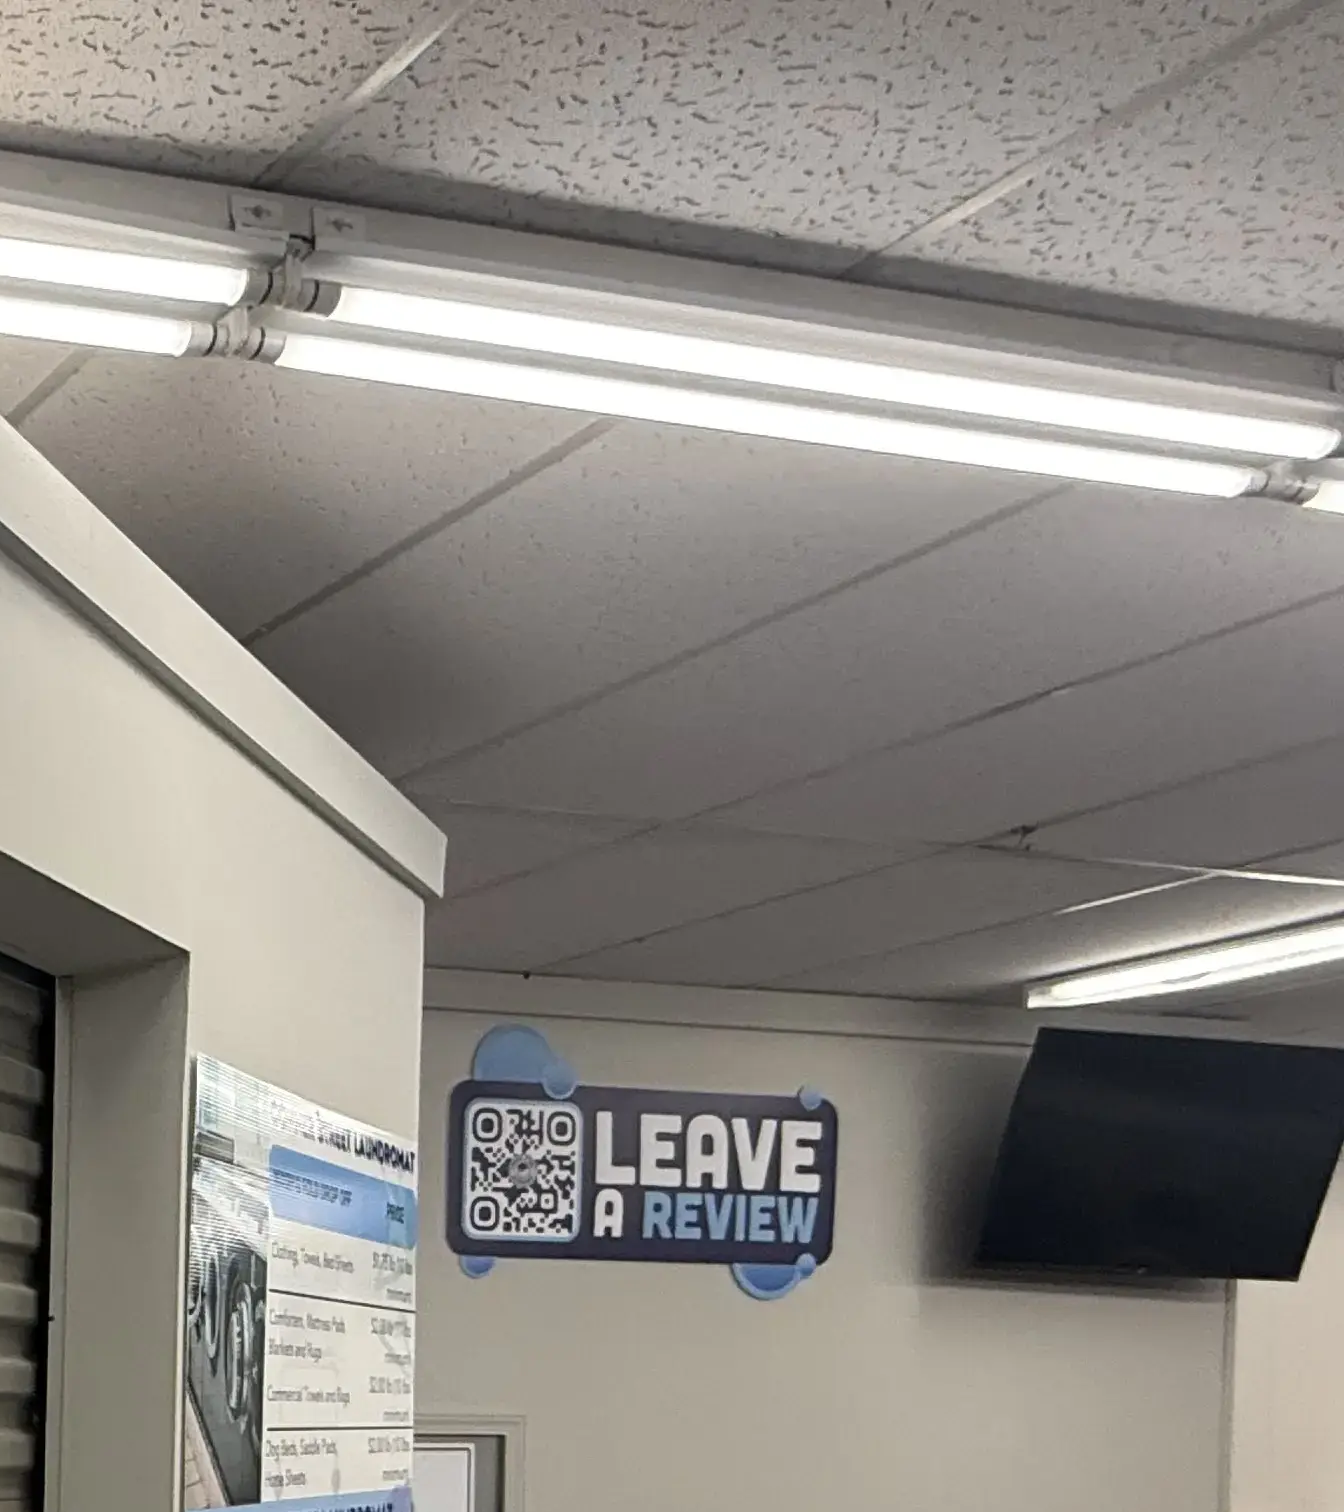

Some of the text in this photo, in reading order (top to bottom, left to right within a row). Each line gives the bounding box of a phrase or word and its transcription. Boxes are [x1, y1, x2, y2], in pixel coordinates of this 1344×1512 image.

[595, 1111, 823, 1192] LEAVE
[593, 1188, 819, 1244] A REVIEW
